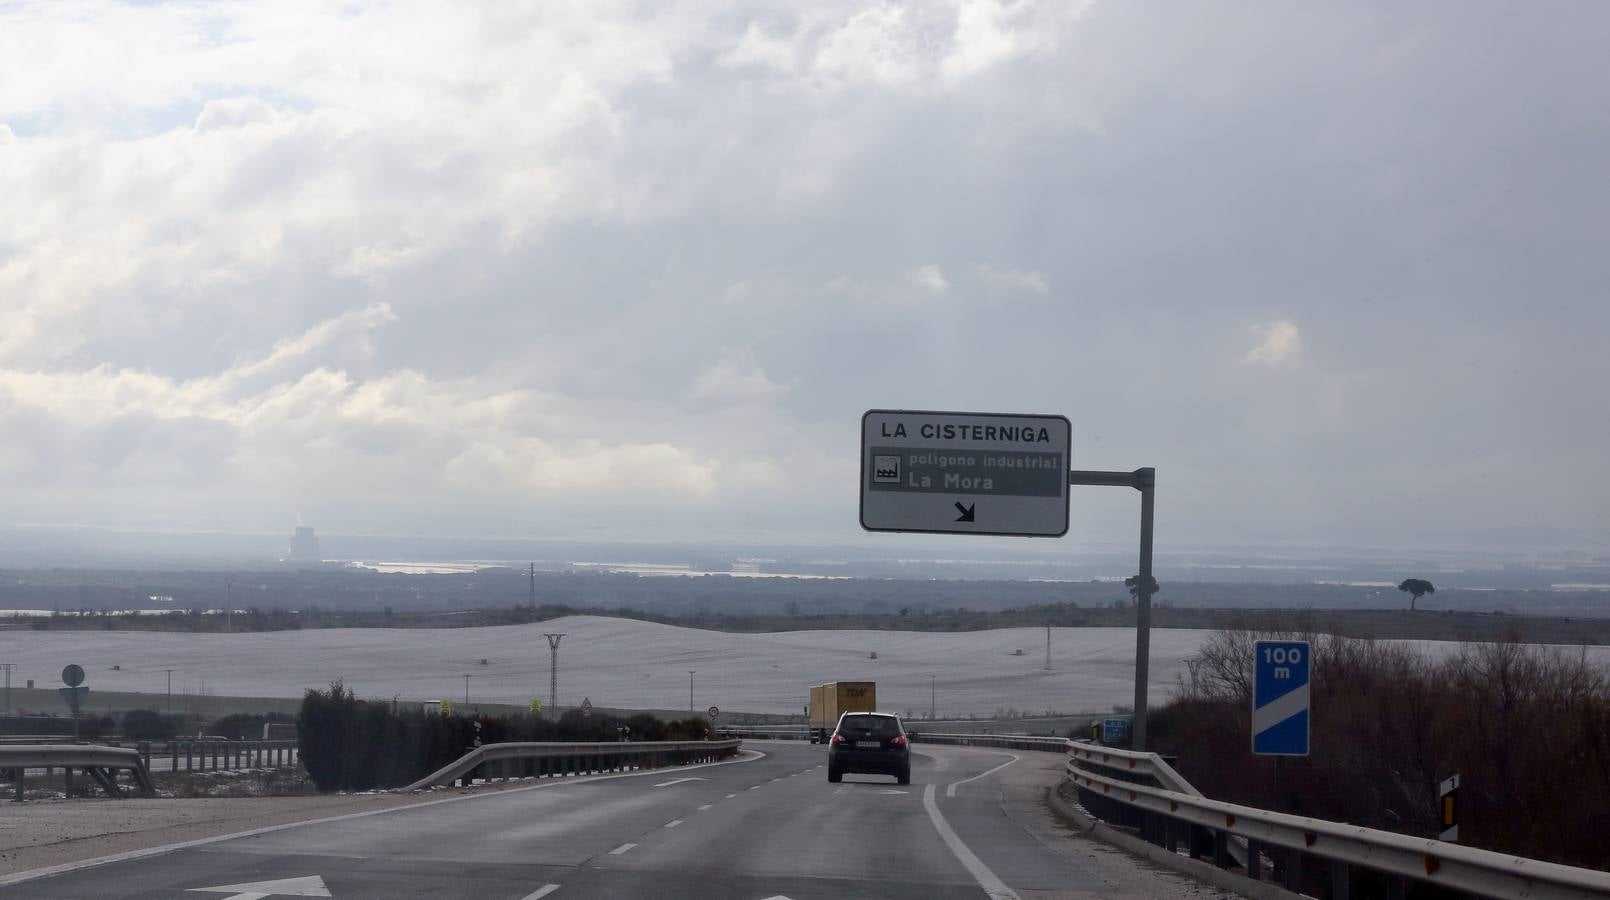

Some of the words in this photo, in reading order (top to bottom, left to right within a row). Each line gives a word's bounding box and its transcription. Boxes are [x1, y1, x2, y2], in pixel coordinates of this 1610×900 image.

[881, 422, 907, 438] LA
[920, 423, 1051, 443] CISTERNIGA
[983, 454, 1058, 470] industrial
[909, 471, 932, 488] La
[944, 473, 994, 490] Mora
[1264, 647, 1301, 664] 100
[1274, 667, 1290, 679] m
